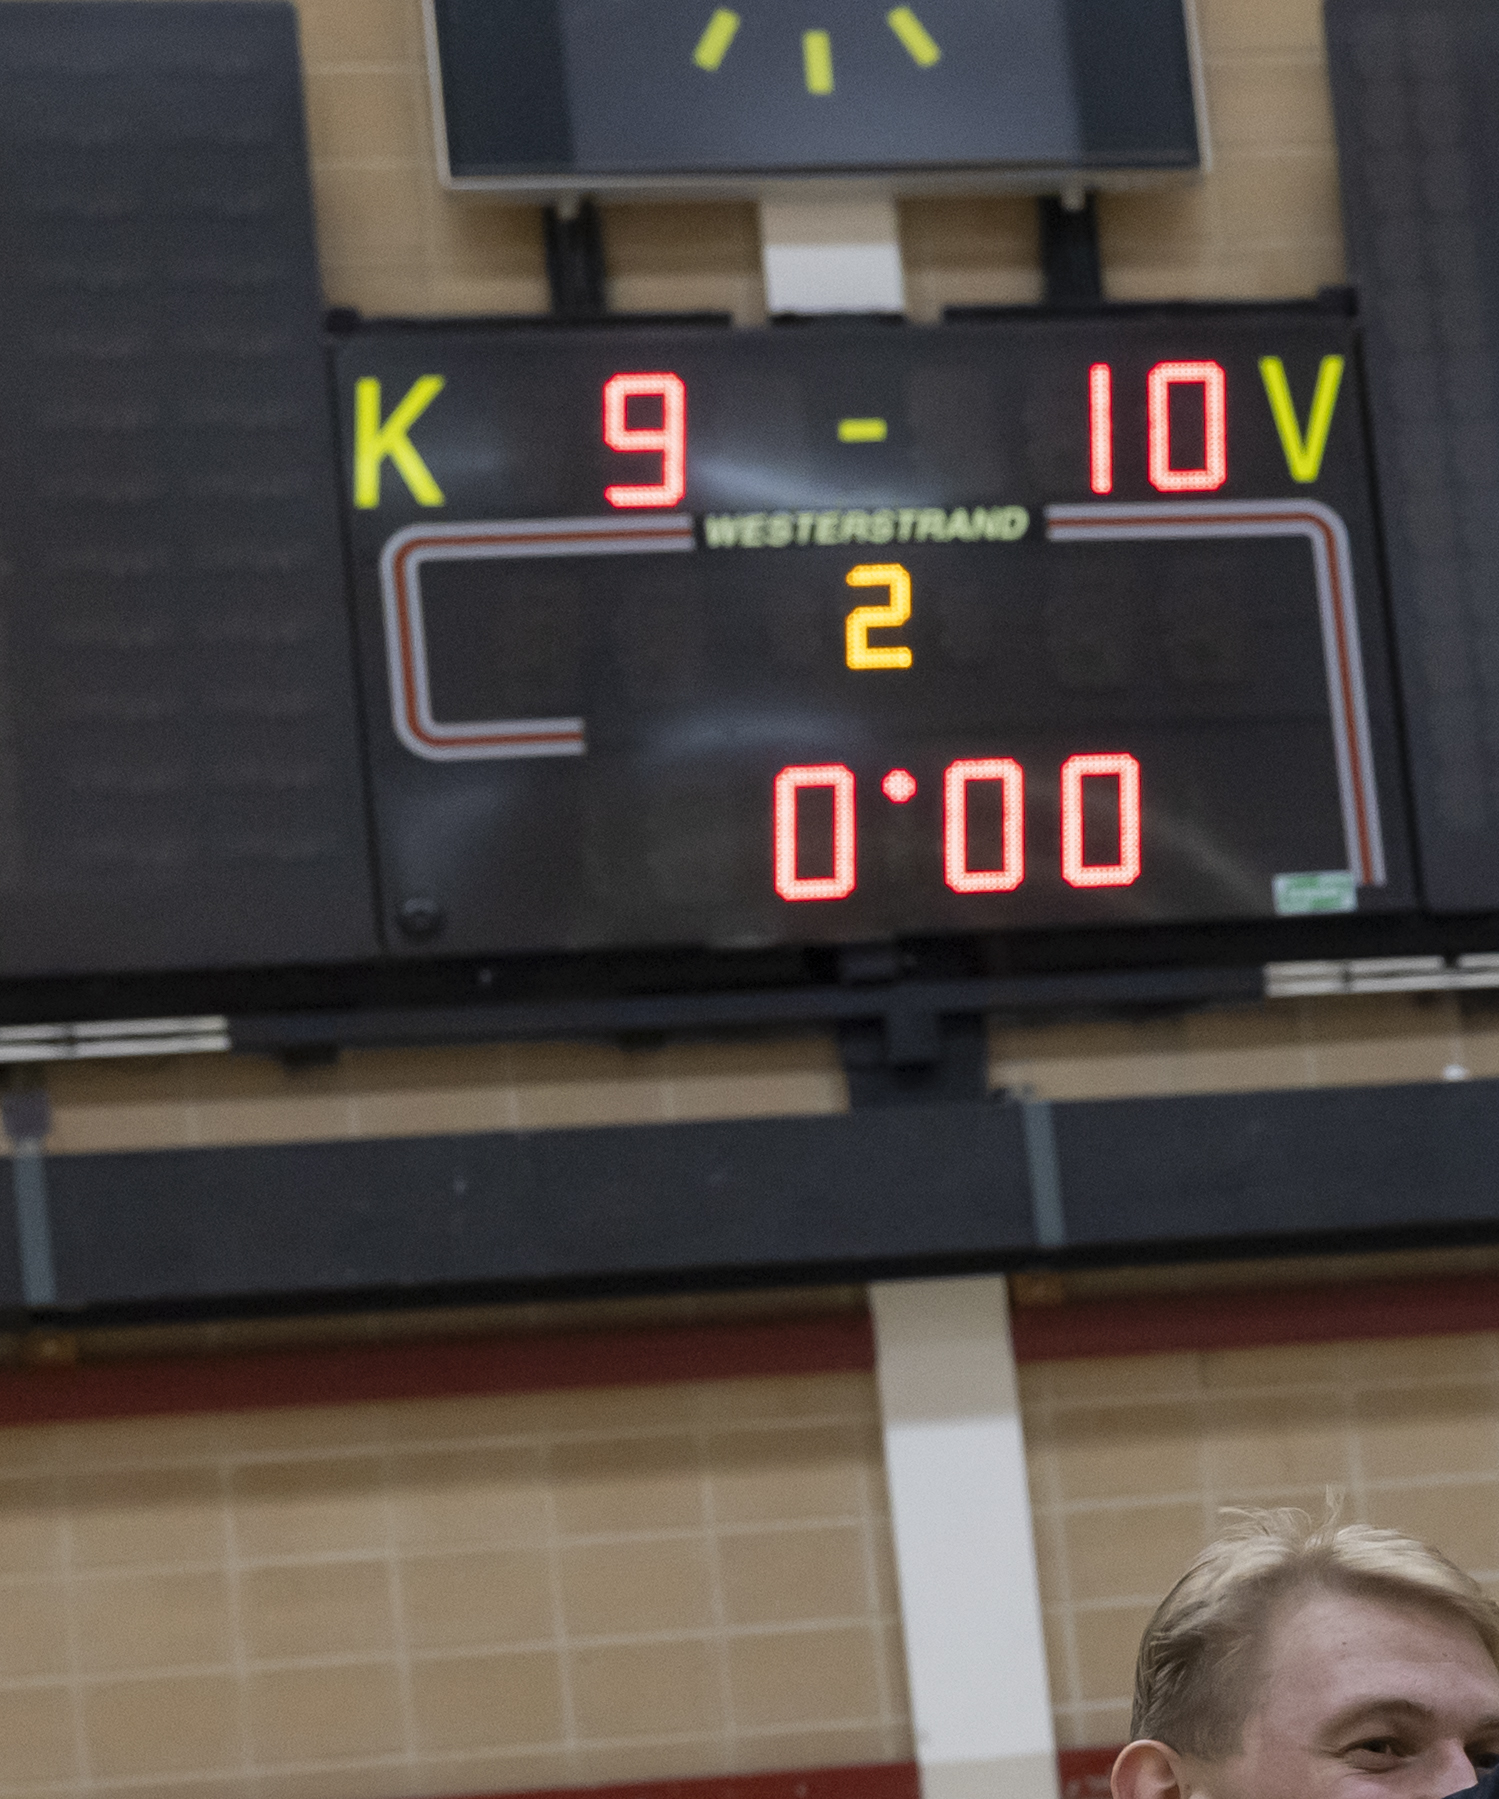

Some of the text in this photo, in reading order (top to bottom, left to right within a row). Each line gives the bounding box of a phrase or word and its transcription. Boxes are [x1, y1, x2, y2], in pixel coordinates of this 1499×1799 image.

[354, 376, 445, 508] K
[602, 371, 688, 509] 9
[1088, 359, 1228, 495] 10
[1259, 355, 1344, 483] V
[703, 505, 1030, 550] WESTERSTRAND
[845, 563, 913, 671] 2
